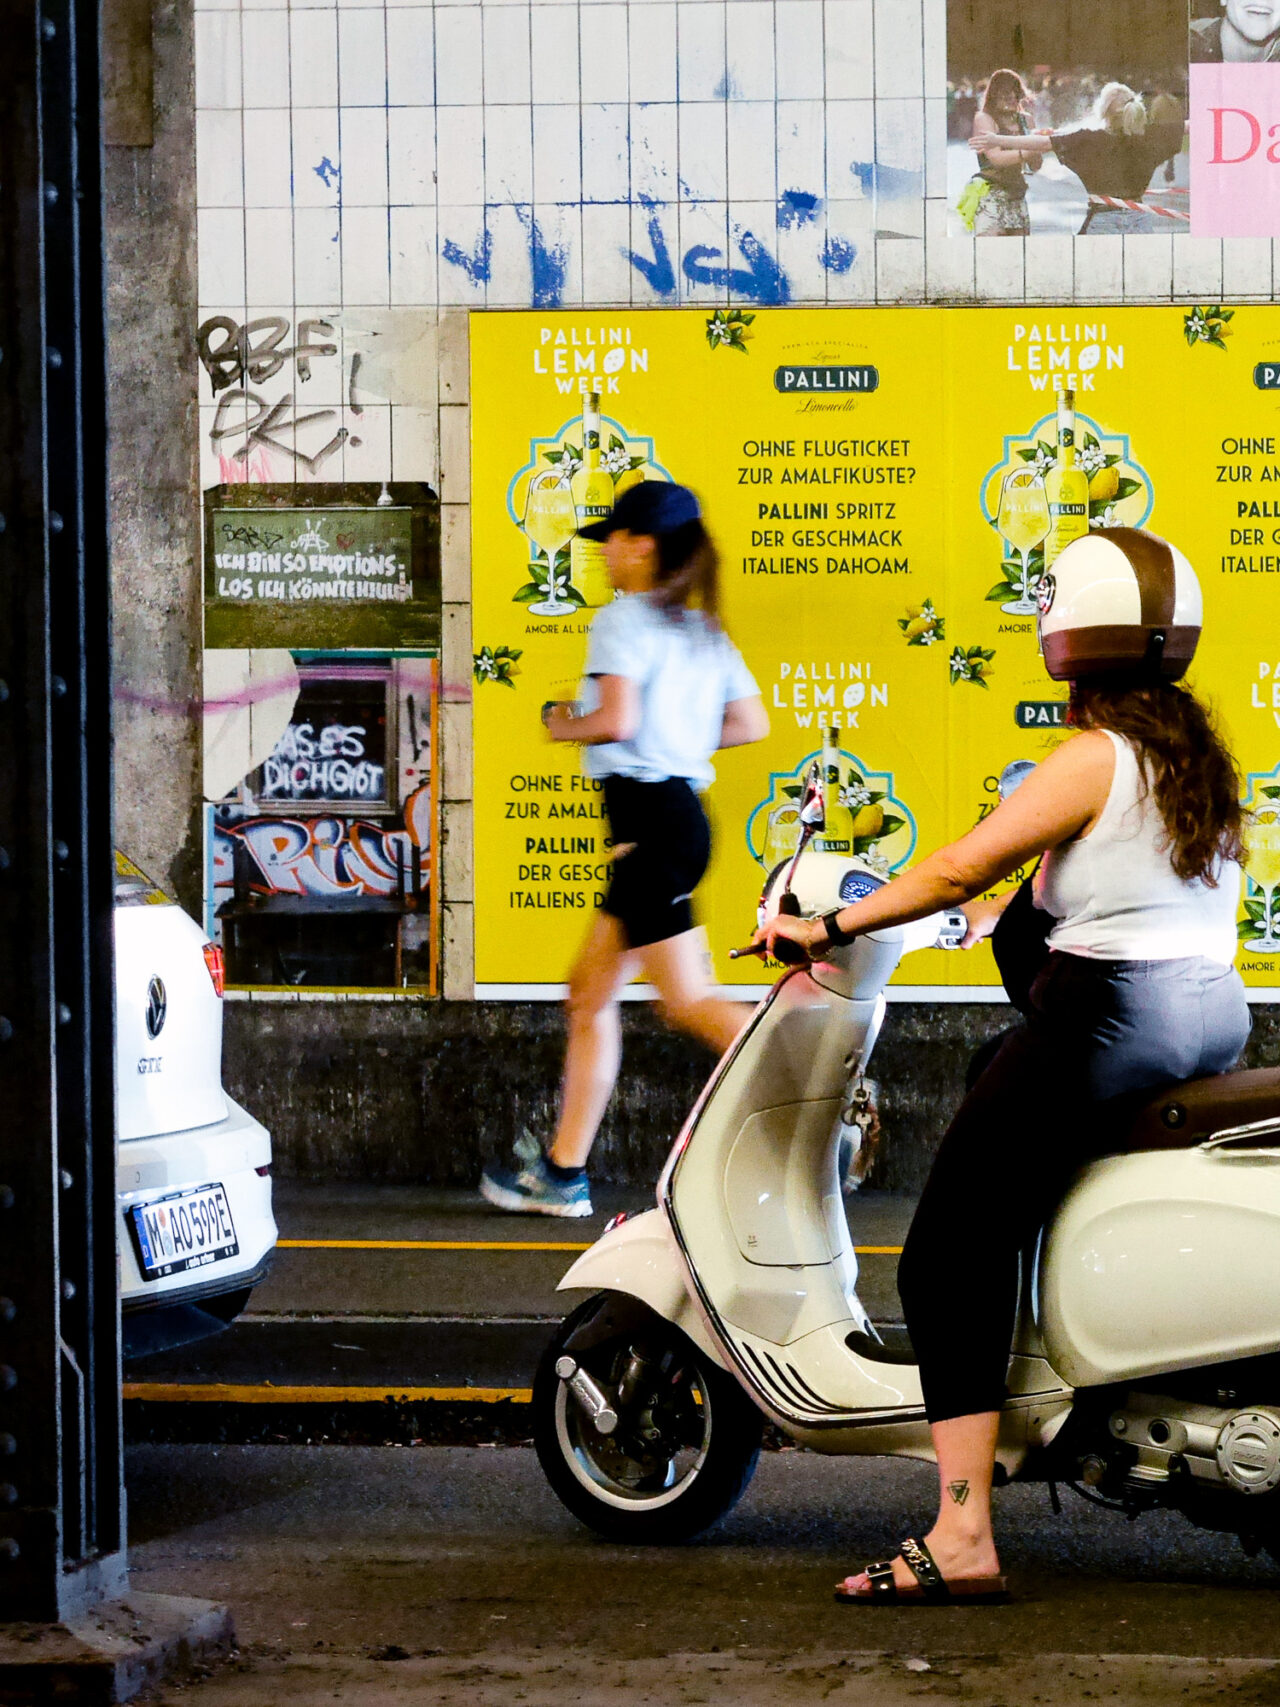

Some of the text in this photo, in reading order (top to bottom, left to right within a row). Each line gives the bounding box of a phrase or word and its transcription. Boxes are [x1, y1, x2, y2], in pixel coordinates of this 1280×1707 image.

[540, 328, 631, 345] PALLINI
[1014, 325, 1107, 341] PALLINI
[533, 348, 648, 373] LEMON
[1008, 345, 1123, 370] LEMON
[555, 377, 620, 395] WEEK
[785, 371, 868, 387] PALLINI
[1029, 374, 1095, 391] WEEK
[743, 440, 910, 457] OHNE FLUGTICKET
[1222, 438, 1275, 455] OHNE
[738, 467, 916, 484] ZUR AMALFIKÜSTE?
[1216, 466, 1252, 482] ZUR
[759, 503, 896, 519] PALLINI SPRITZ
[752, 530, 902, 547] DER GESCHMACK
[1231, 529, 1264, 545] DER
[743, 557, 912, 574] ITALIENS DAHOAM.
[525, 625, 558, 633] AMORE
[563, 625, 574, 633] AL
[998, 624, 1032, 633] AMORE
[780, 663, 871, 679] PALLINI
[773, 683, 888, 708] LEMON
[795, 712, 859, 729] WEEK
[510, 775, 563, 792] OHNE
[505, 802, 540, 819] ZUR
[526, 837, 594, 854] PALLINI
[519, 864, 551, 881] DER
[510, 892, 586, 908] ITALIENS
[1241, 962, 1274, 971] AMORE
